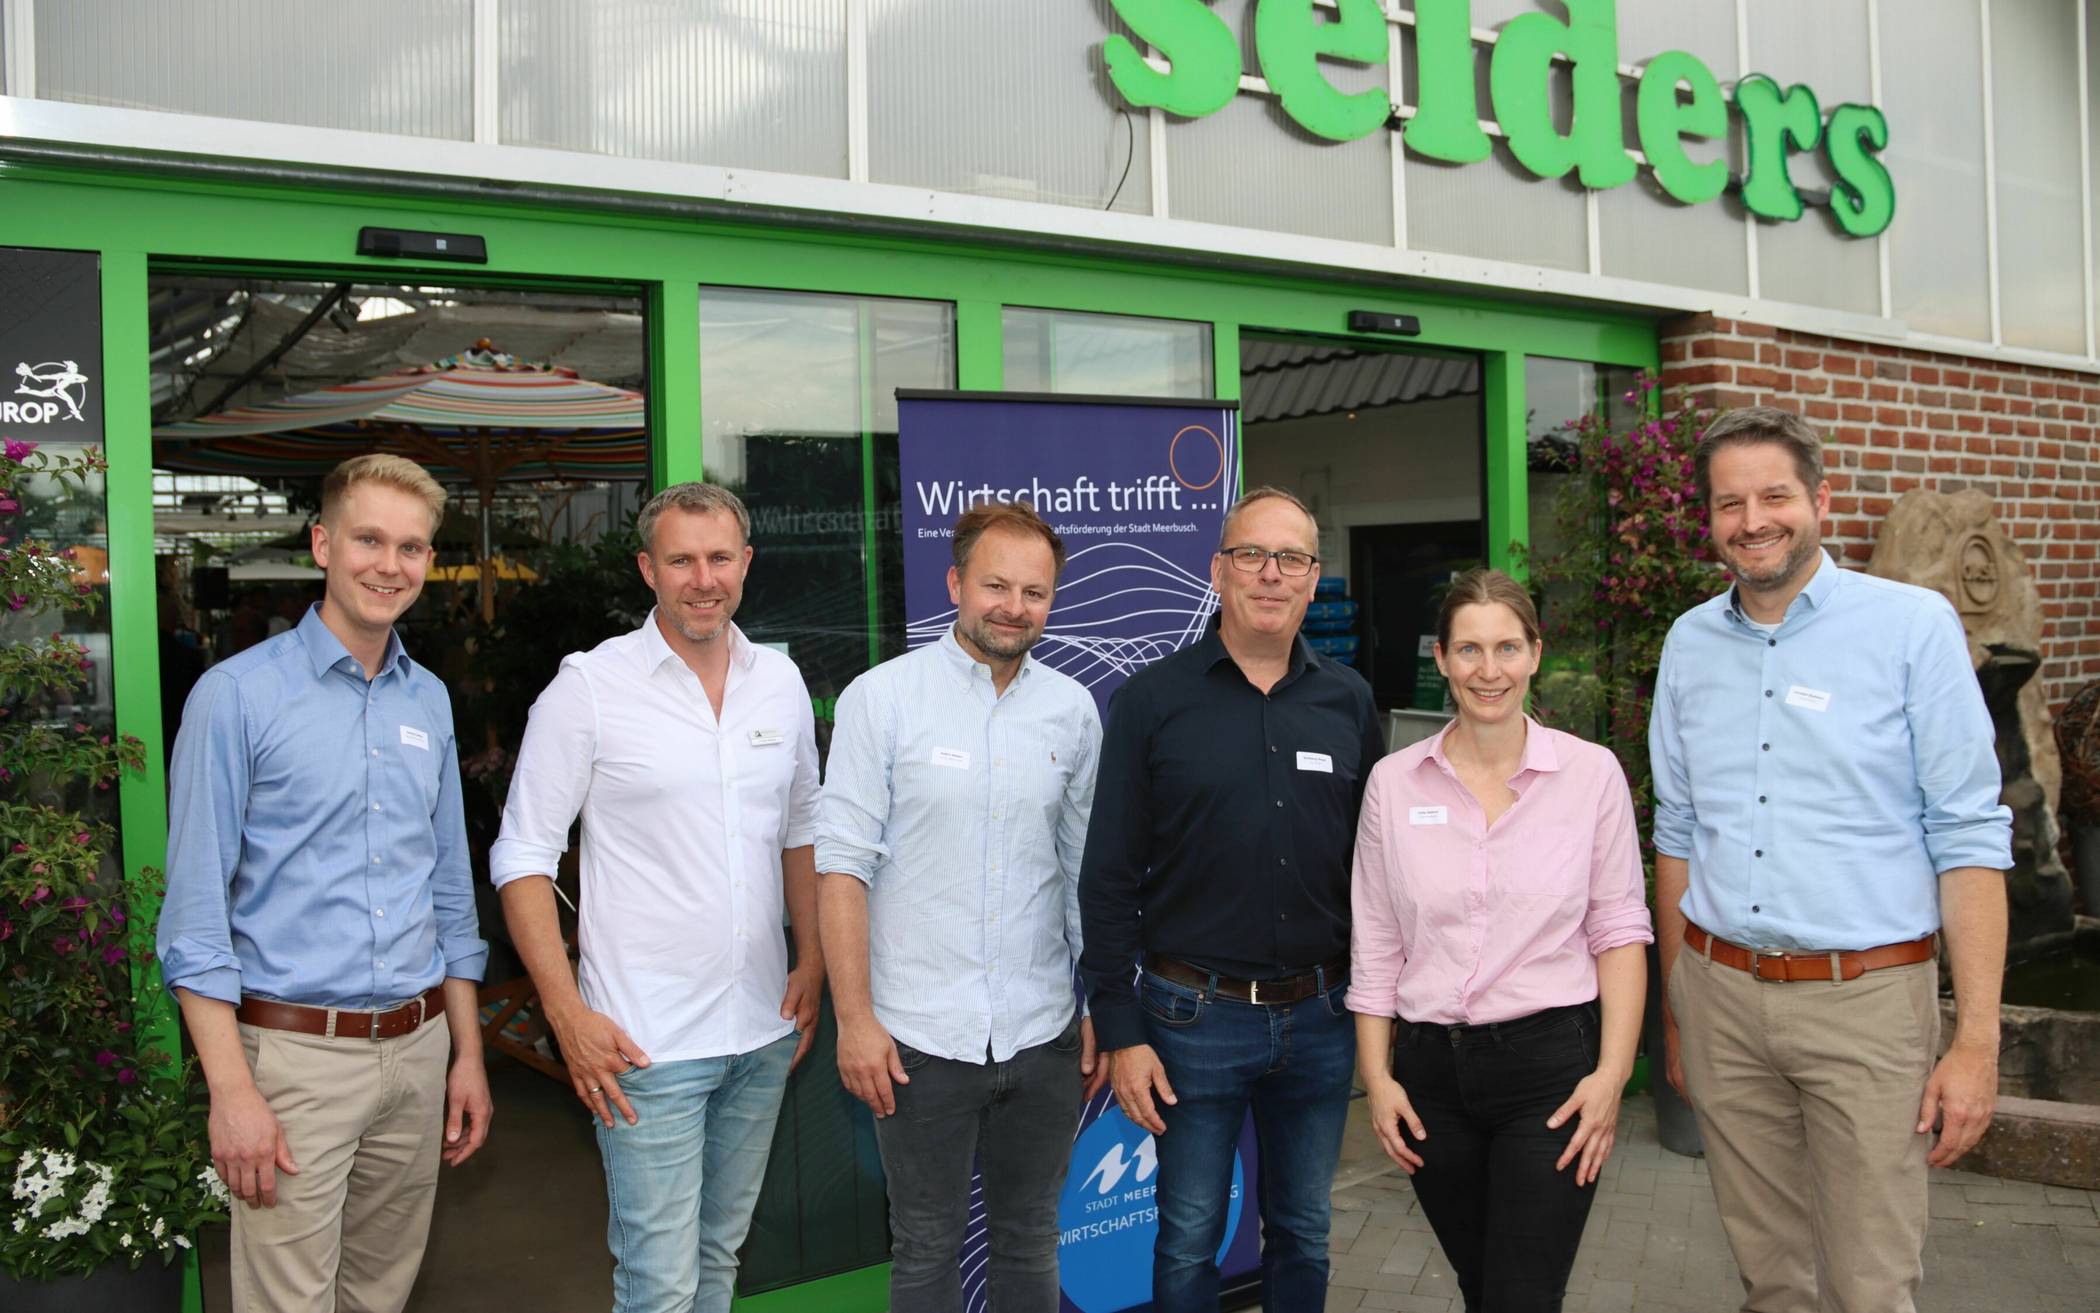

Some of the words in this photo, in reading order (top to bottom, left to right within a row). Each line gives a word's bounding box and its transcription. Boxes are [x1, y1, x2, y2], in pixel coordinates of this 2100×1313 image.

[0, 401, 59, 423] ROP
[916, 476, 1101, 516] Wirtschaft
[1107, 475, 1182, 511] trifft
[917, 528, 939, 539] Eine
[939, 527, 955, 538] Ver
[1113, 523, 1128, 534] der
[1128, 522, 1151, 533] Stadt
[1152, 522, 1199, 533] Meerbusch.
[1085, 1195, 1119, 1214] STADT
